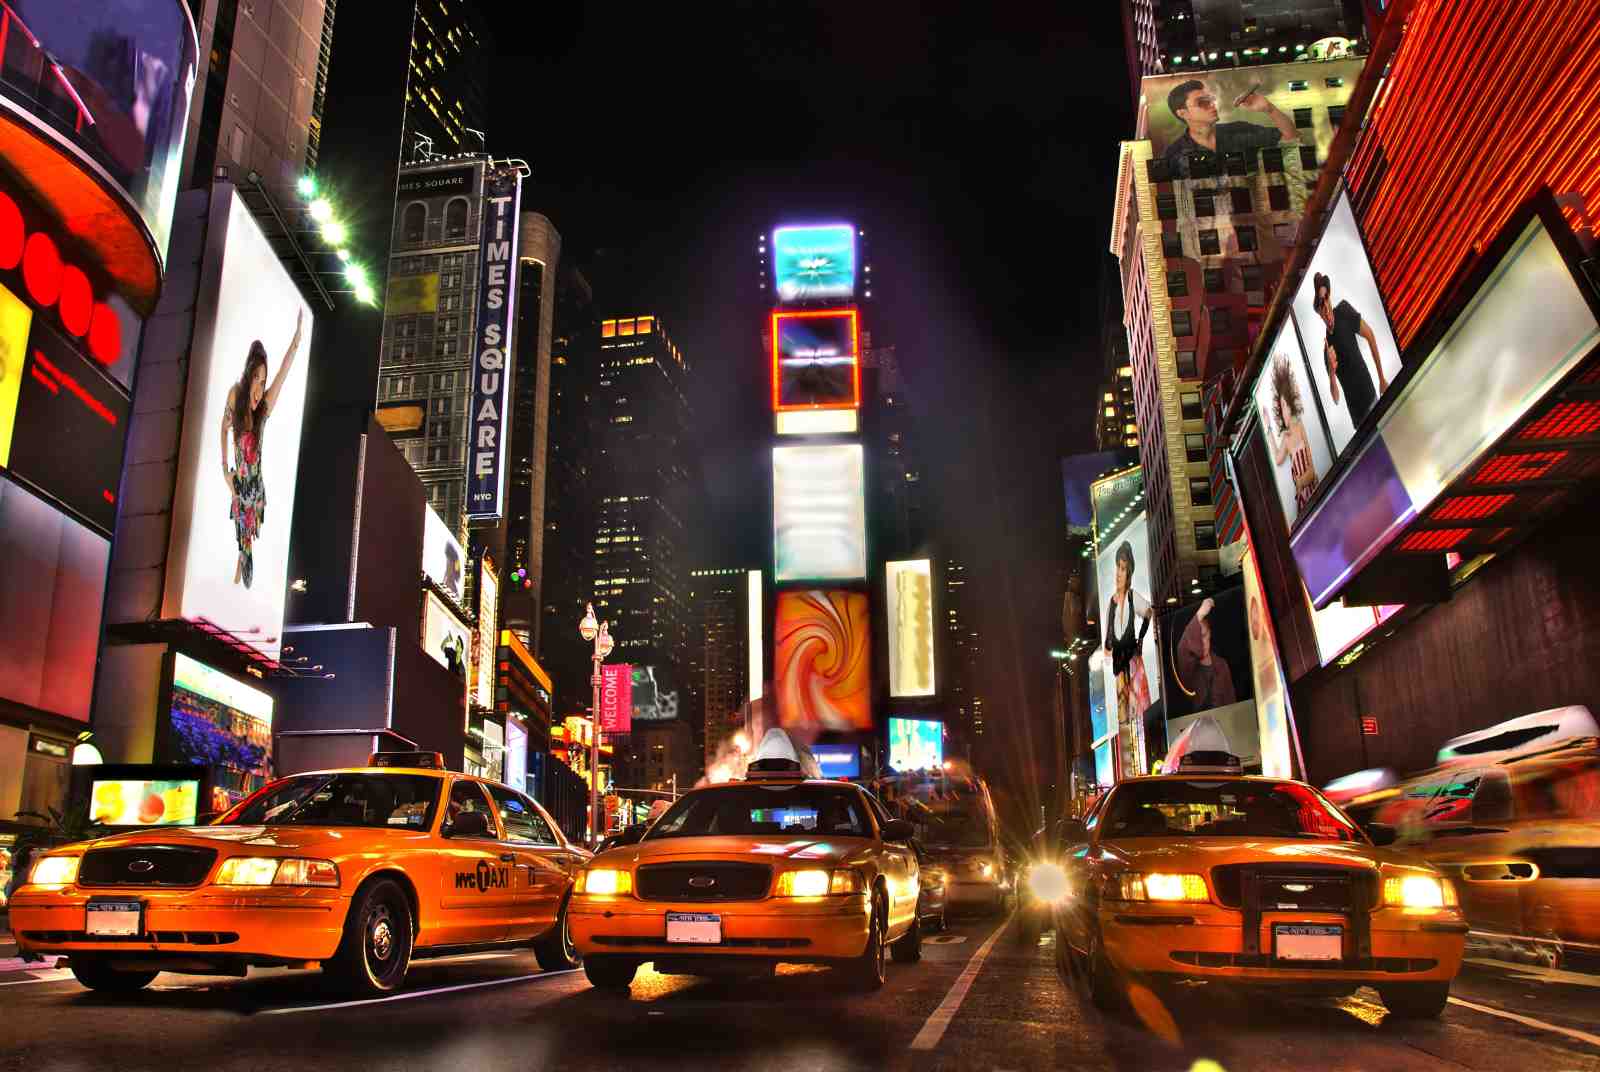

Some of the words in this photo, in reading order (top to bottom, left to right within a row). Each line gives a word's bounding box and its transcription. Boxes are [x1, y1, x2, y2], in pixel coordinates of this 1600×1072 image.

[424, 177, 465, 188] SQUARE
[487, 196, 512, 309] TIMES
[475, 323, 504, 475] SQUARE
[474, 493, 492, 501] NYC
[604, 669, 617, 729] WELCOME
[456, 872, 476, 888] NYC
